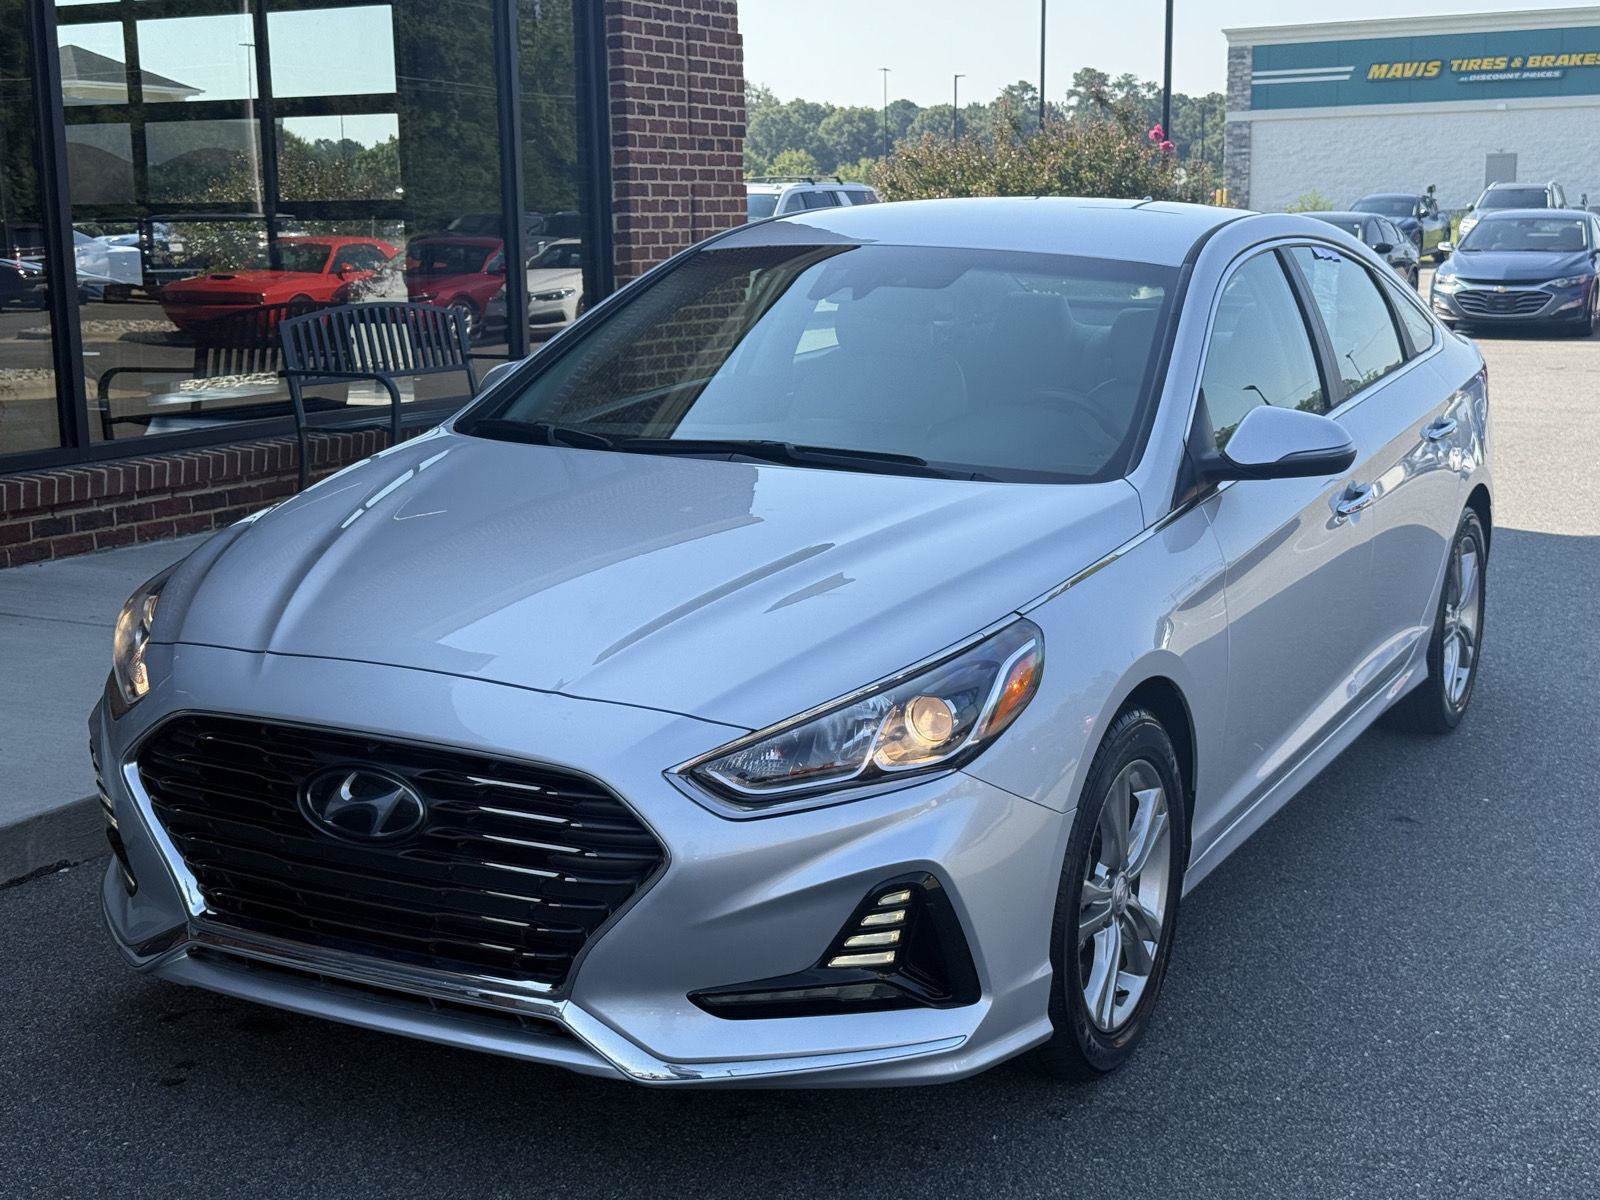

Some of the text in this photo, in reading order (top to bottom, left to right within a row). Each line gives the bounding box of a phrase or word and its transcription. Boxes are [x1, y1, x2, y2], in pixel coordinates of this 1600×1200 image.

[1366, 60, 1442, 79] MAVIS
[1451, 56, 1507, 72] TIRES
[1511, 57, 1523, 68] &
[1469, 72, 1521, 81] DISCOUNT
[1522, 70, 1561, 79] PRICES
